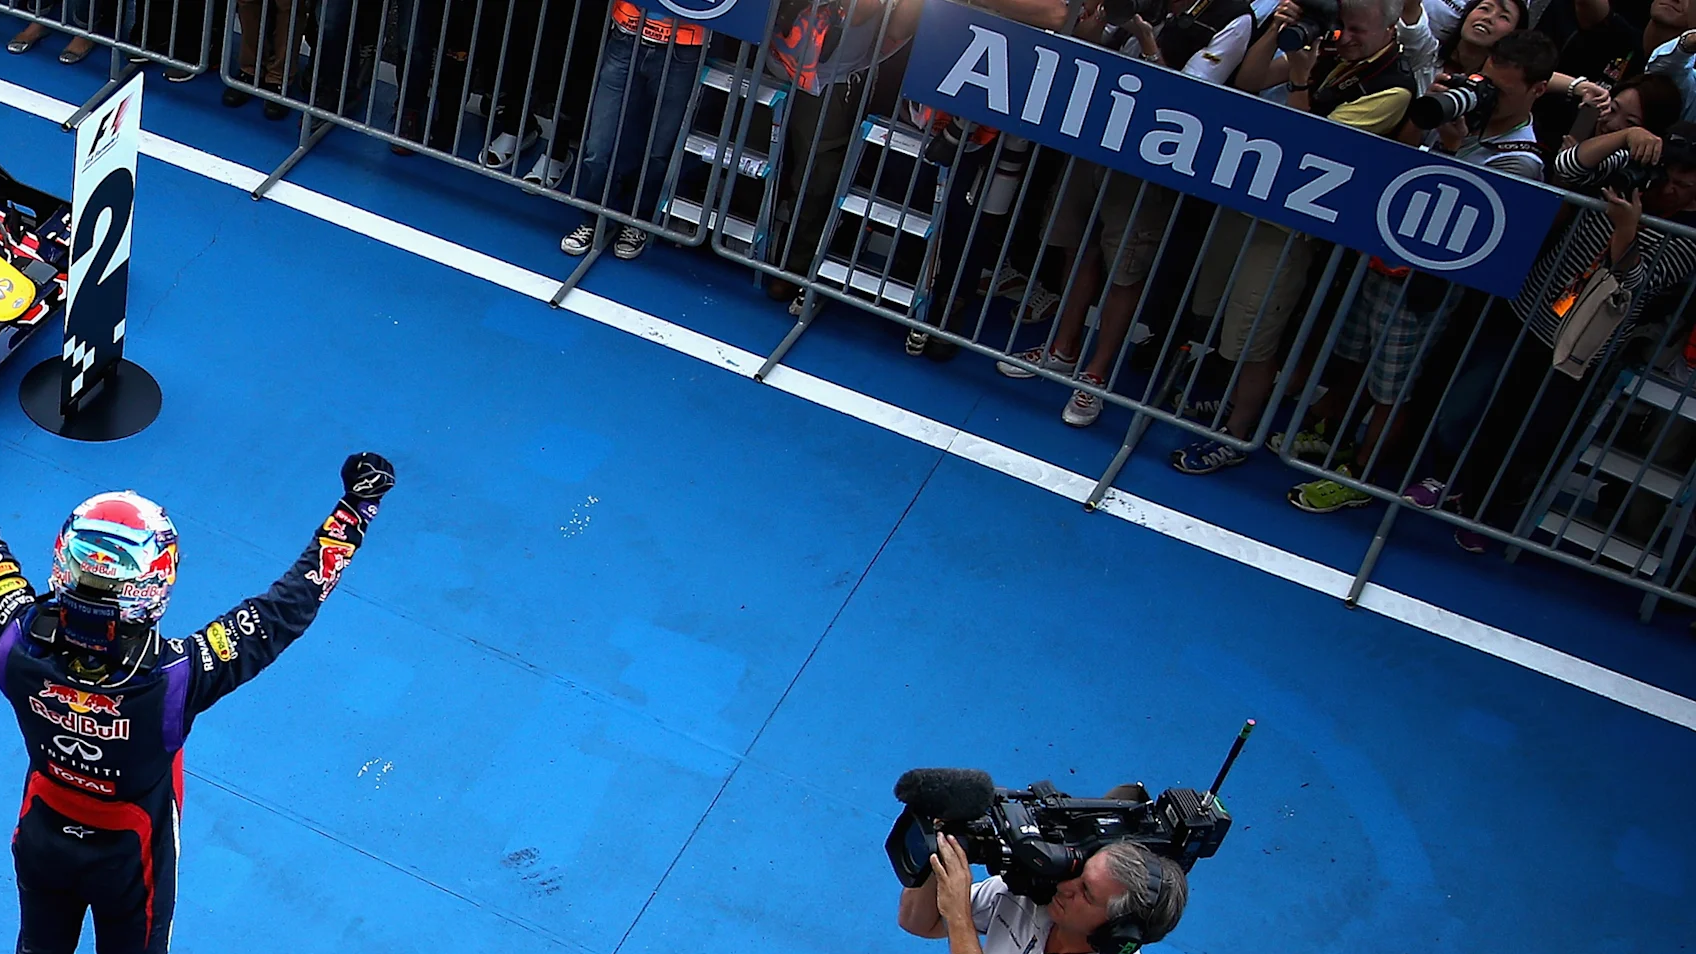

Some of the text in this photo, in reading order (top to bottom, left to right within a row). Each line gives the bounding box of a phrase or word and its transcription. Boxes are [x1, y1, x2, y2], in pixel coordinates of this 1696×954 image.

[1338, 75, 1359, 91] EOS
[936, 24, 1356, 224] Allianz
[65, 168, 134, 350] 2
[123, 583, 147, 598] Red
[192, 632, 215, 673] RENAU
[28, 695, 131, 741] Red Bull
[40, 743, 122, 777] INFINITI
[50, 763, 113, 793] TOTAL
